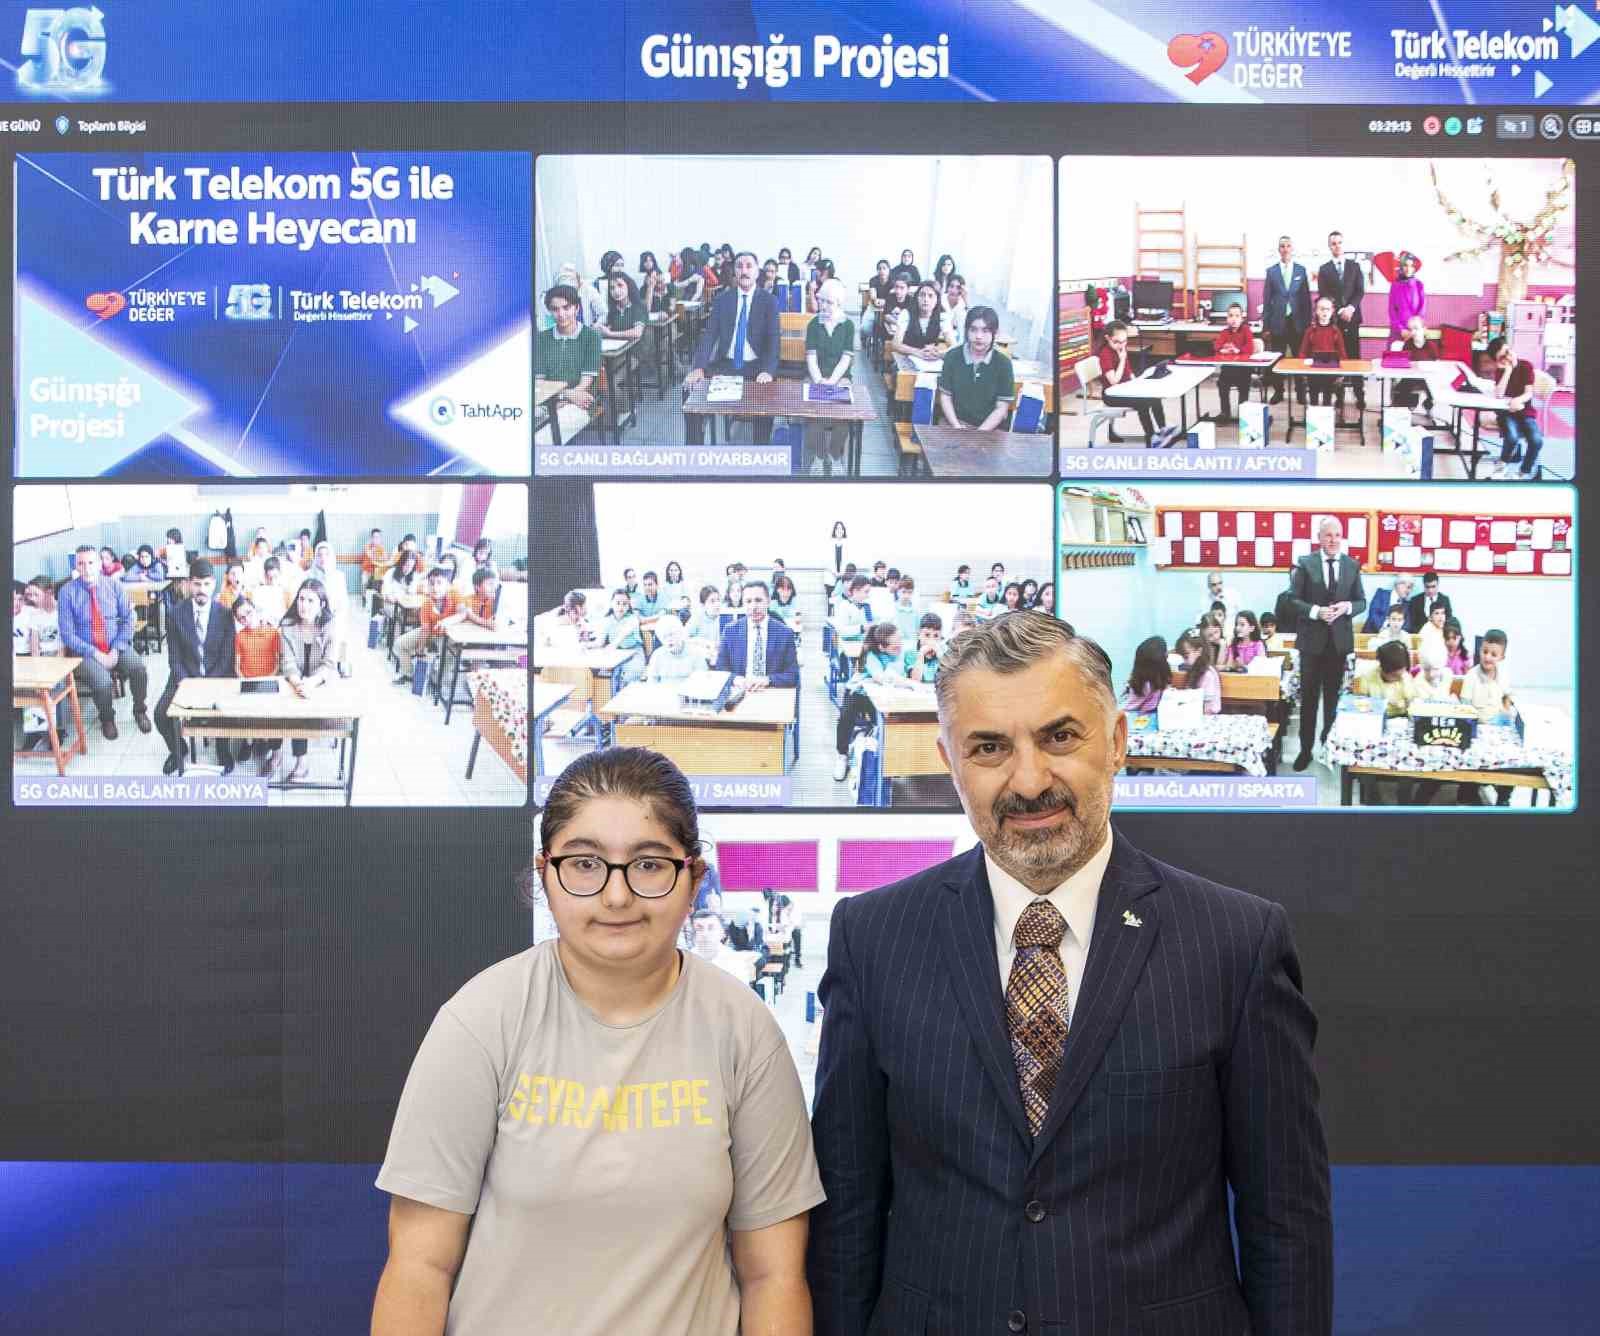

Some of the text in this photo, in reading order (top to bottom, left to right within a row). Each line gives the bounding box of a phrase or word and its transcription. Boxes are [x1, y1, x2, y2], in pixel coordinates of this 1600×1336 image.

[17, 6, 107, 92] 5G
[1232, 27, 1352, 58] TÜRKİYE'YE
[1391, 29, 1558, 61] Türk Telekom
[640, 33, 949, 89] Günışığı Projesi
[1234, 58, 1304, 89] DEĞER
[92, 165, 454, 201] Türk Telekom 5G ile
[130, 211, 417, 251] Karne Heyecanı
[128, 288, 207, 307] TÜRKİYE'YE
[224, 284, 273, 320] 5G
[290, 290, 423, 311] Türk Telekom
[128, 305, 176, 322] DEĞER
[31, 376, 142, 408] Günışığı
[31, 411, 125, 443] Projesi
[460, 403, 524, 421] TahtApp
[540, 452, 561, 466] 5G
[563, 452, 608, 466] CANLI
[611, 449, 687, 466] BAĞLANTI
[1066, 455, 1089, 471] 5G
[1092, 455, 1144, 471] CANLI
[1148, 453, 1232, 471] BAĞLANTI
[1244, 456, 1302, 471] AFYON
[20, 783, 42, 800] 5G
[47, 783, 99, 800] CANLI
[103, 781, 191, 800] BAĞLANTI
[204, 783, 264, 800] KONYA
[712, 783, 781, 799] SAMSUN
[1143, 780, 1226, 799] BAĞLANTI
[1238, 783, 1305, 799] ISPARTA
